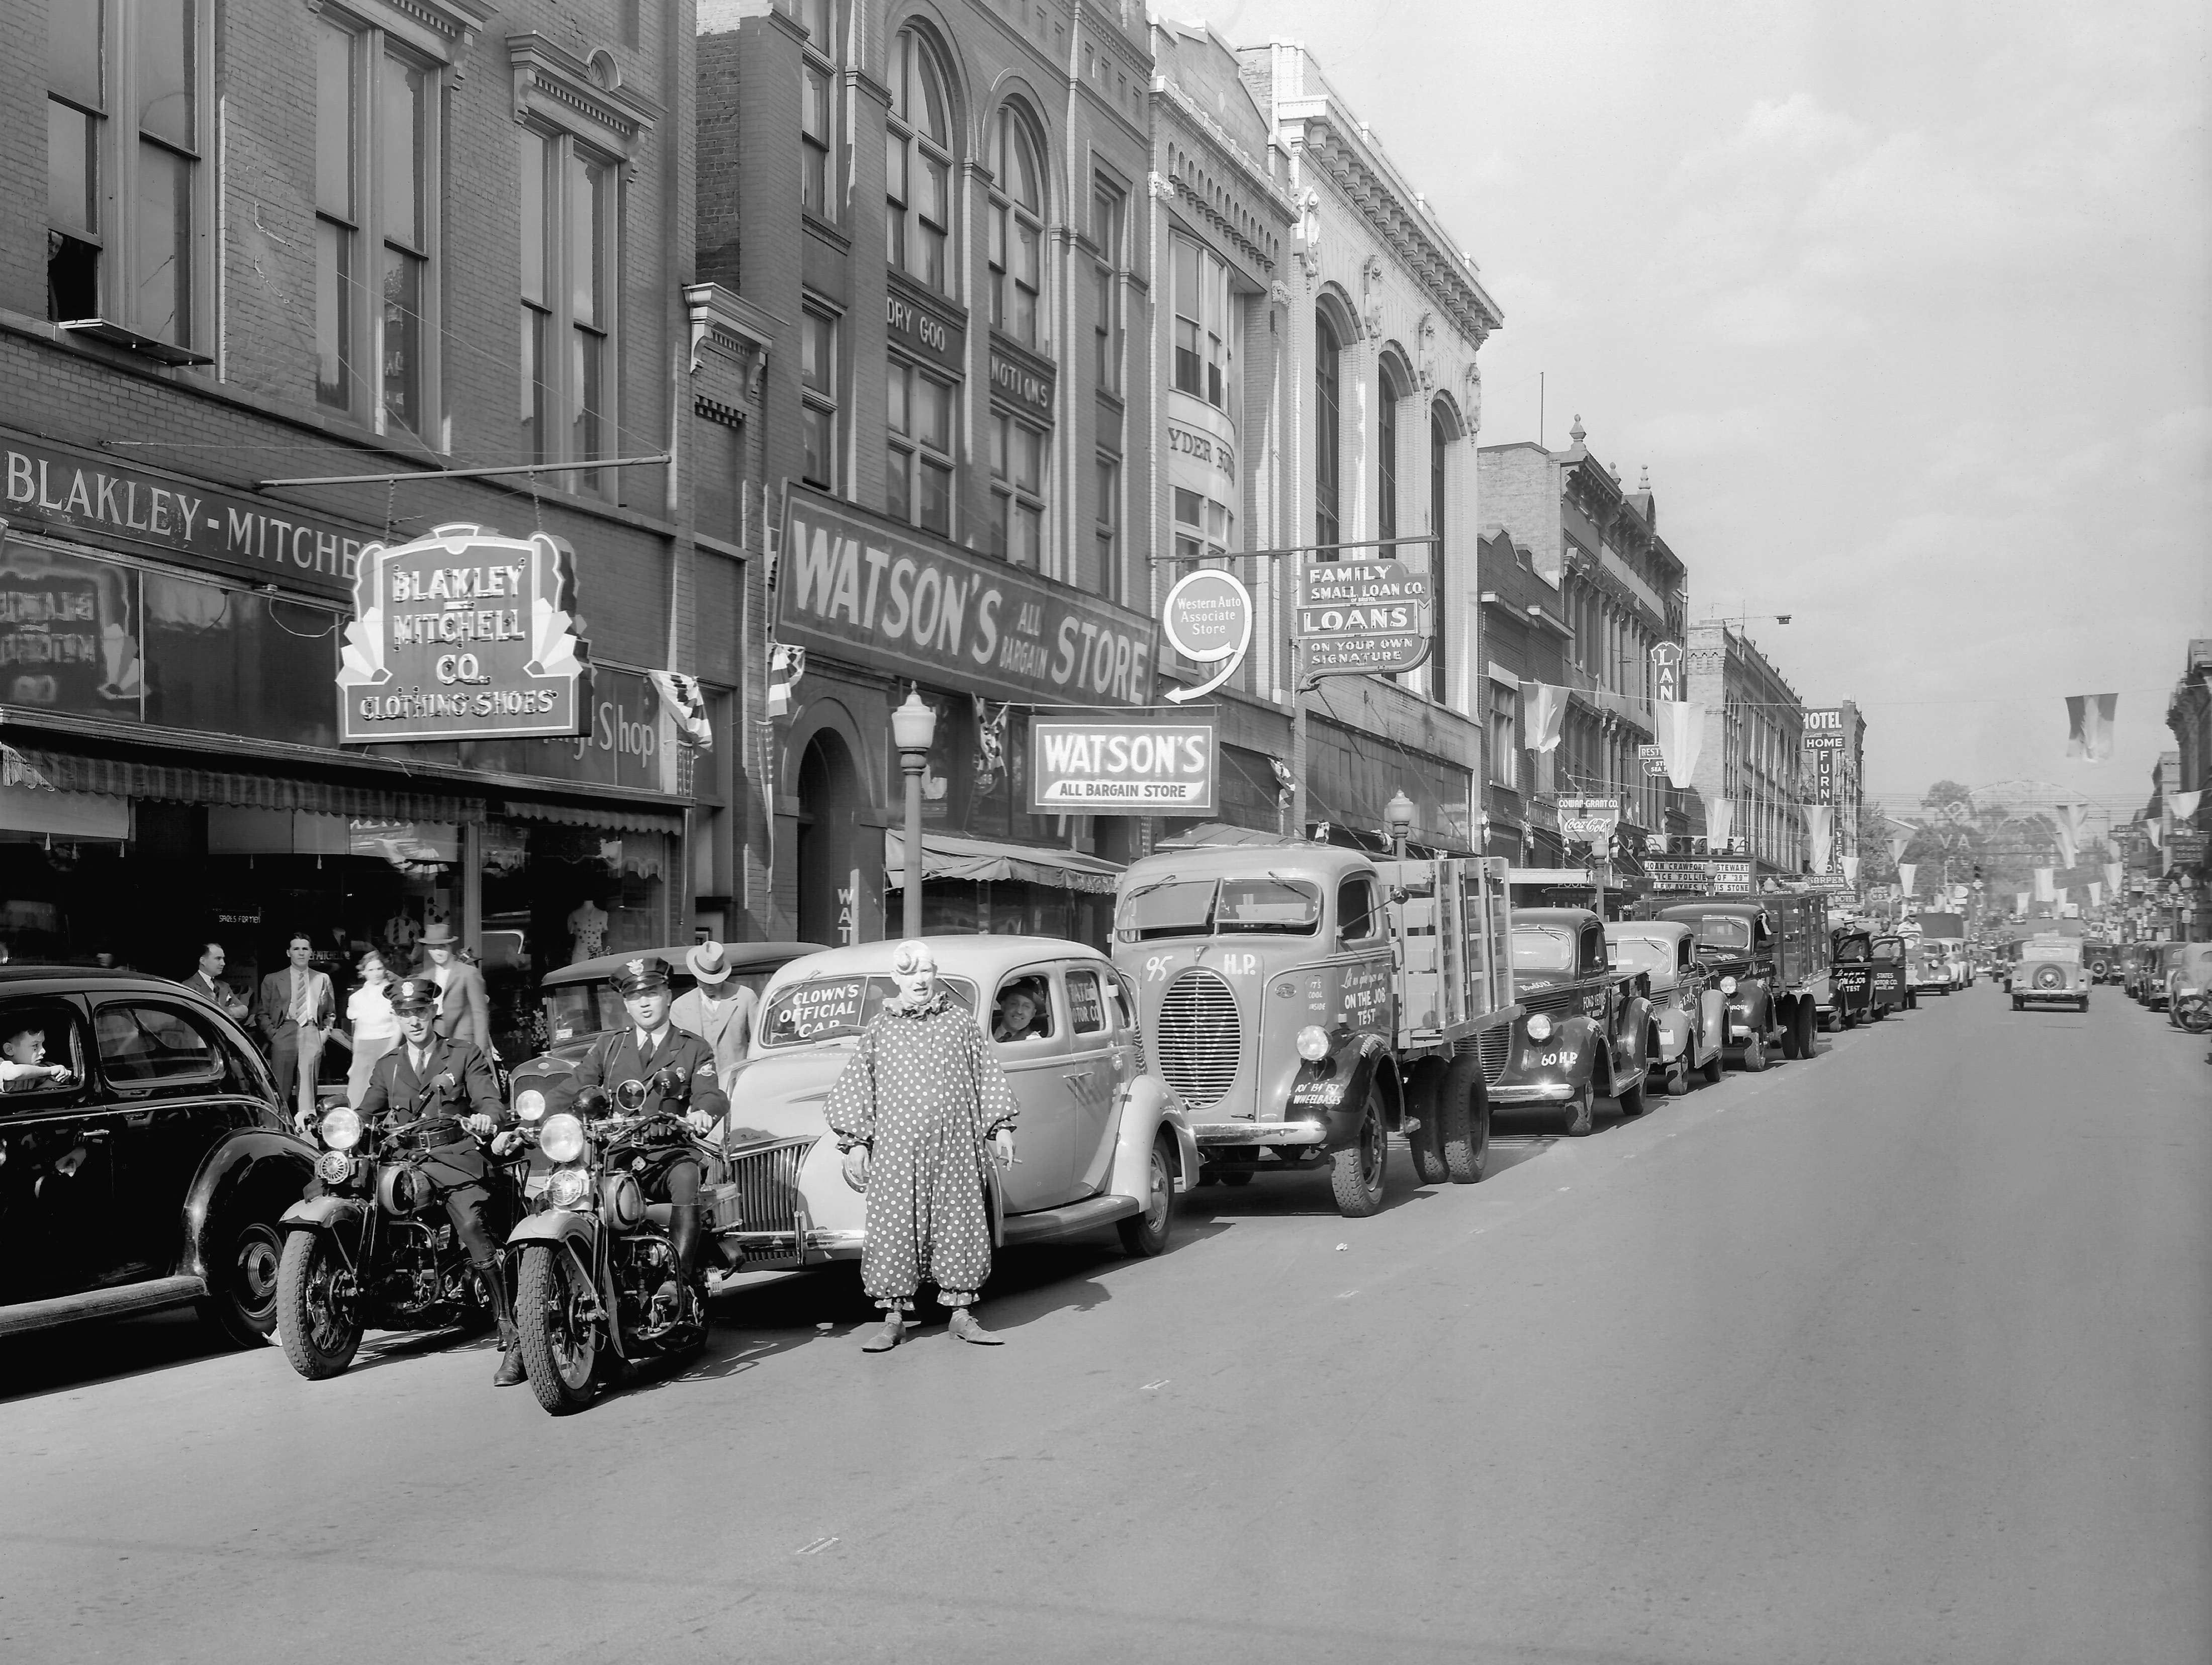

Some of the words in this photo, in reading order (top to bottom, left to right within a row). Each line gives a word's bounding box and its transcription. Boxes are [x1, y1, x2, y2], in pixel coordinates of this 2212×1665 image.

[887, 297, 911, 333] DRY
[920, 316, 946, 352] GOO
[992, 356, 1048, 408] NOTIONS
[392, 565, 526, 602] BLAKLEY
[1310, 565, 1392, 583] FAMILY
[793, 520, 1002, 664] WATSON'S
[1311, 585, 1358, 601] SMALL
[1362, 583, 1400, 598] LOAN
[1404, 582, 1426, 594] CO.
[1177, 597, 1216, 610] Western
[1219, 596, 1241, 608] Auto
[1018, 602, 1042, 636] ALL
[1180, 610, 1236, 622] Associate
[1304, 607, 1407, 632] LOANS
[393, 609, 525, 645] MITCHELL
[1192, 623, 1226, 634] Store
[1311, 641, 1330, 652] ON
[1335, 639, 1375, 651] YOUR
[1380, 638, 1413, 649] OWN
[1000, 634, 1049, 680] BARGAIN
[1051, 616, 1147, 705] STORE
[1311, 651, 1402, 665] SIGNATURE
[436, 653, 491, 685] CO.
[359, 692, 469, 719] CLOTHING
[471, 689, 555, 717] SHOES
[1802, 711, 1842, 729] HOTEL
[599, 702, 654, 768] Shop
[1806, 738, 1843, 748] HOME
[1044, 734, 1205, 774] WATSON'S
[1641, 748, 1663, 757] REST
[1059, 783, 1082, 797] ALL
[1085, 783, 1139, 798] BARGAIN
[1144, 784, 1186, 798] STORE
[1667, 837, 1734, 855] STAE
[837, 888, 855, 944] WAT
[1146, 955, 1174, 982] 95
[1224, 953, 1256, 976] H.P.
[1310, 979, 1322, 989] IT'S
[792, 984, 860, 1006] CLOWN'S
[1308, 991, 1323, 999] COOL
[1344, 993, 1356, 1009] ON
[1357, 990, 1372, 1007] THE
[1373, 986, 1386, 1004] JOB
[779, 1000, 856, 1023] OFFICIAL
[1308, 1002, 1326, 1010] INSIDE
[1357, 1008, 1376, 1026] TEST
[1541, 1053, 1557, 1066] 60
[1559, 1052, 1578, 1064] H.P.
[1293, 1094, 1342, 1105] WHEELBASES
